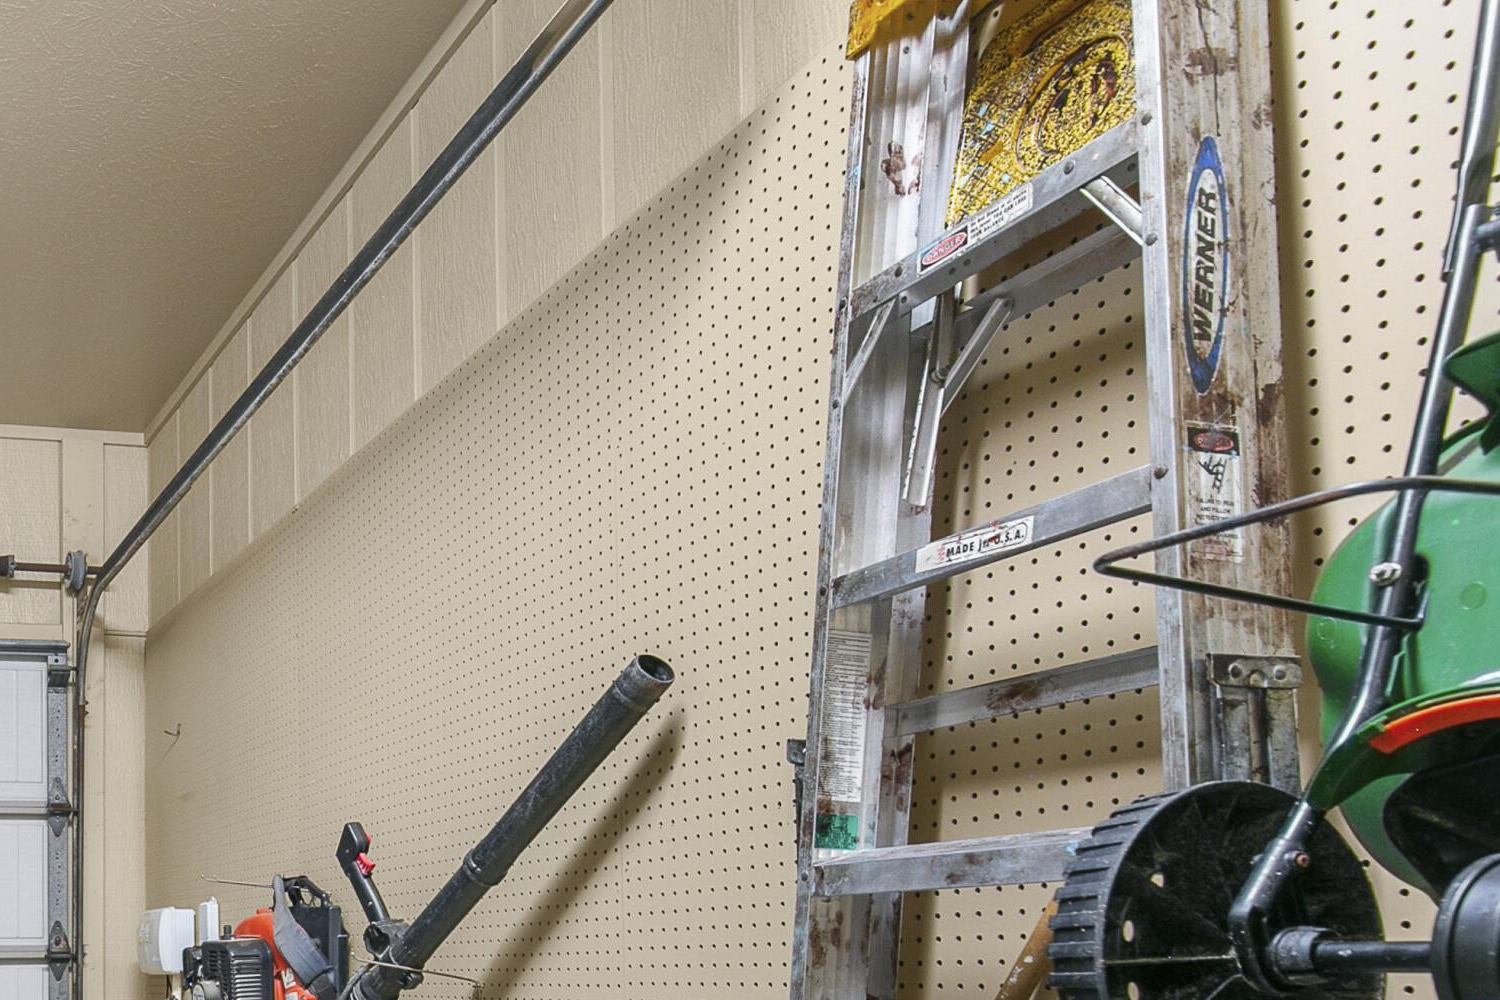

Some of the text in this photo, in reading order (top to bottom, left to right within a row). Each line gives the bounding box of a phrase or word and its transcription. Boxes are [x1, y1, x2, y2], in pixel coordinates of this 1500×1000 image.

[925, 236, 962, 261] DANGER
[1192, 187, 1218, 342] WERNER
[946, 541, 975, 557] MADE
